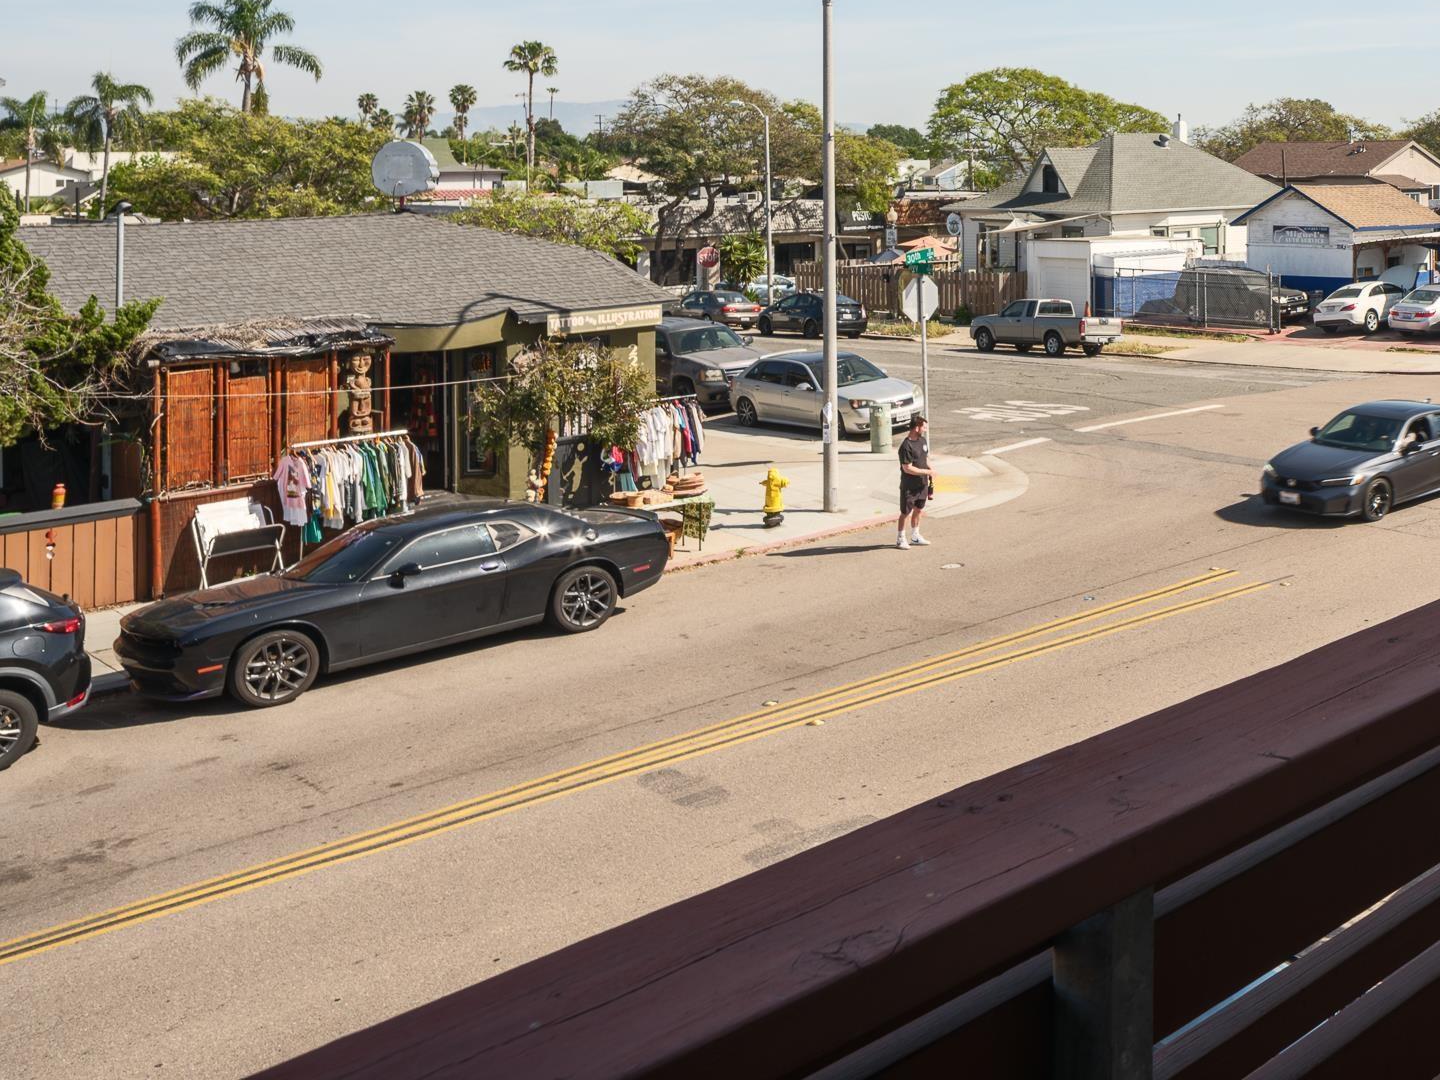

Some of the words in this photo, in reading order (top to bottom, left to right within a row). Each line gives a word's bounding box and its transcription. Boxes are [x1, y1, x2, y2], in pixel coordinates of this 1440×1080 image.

[1285, 230, 1325, 239] Miguel's
[699, 253, 719, 263] STOP
[549, 316, 585, 330] TATTOO
[598, 308, 660, 326] ILLUSTRATION
